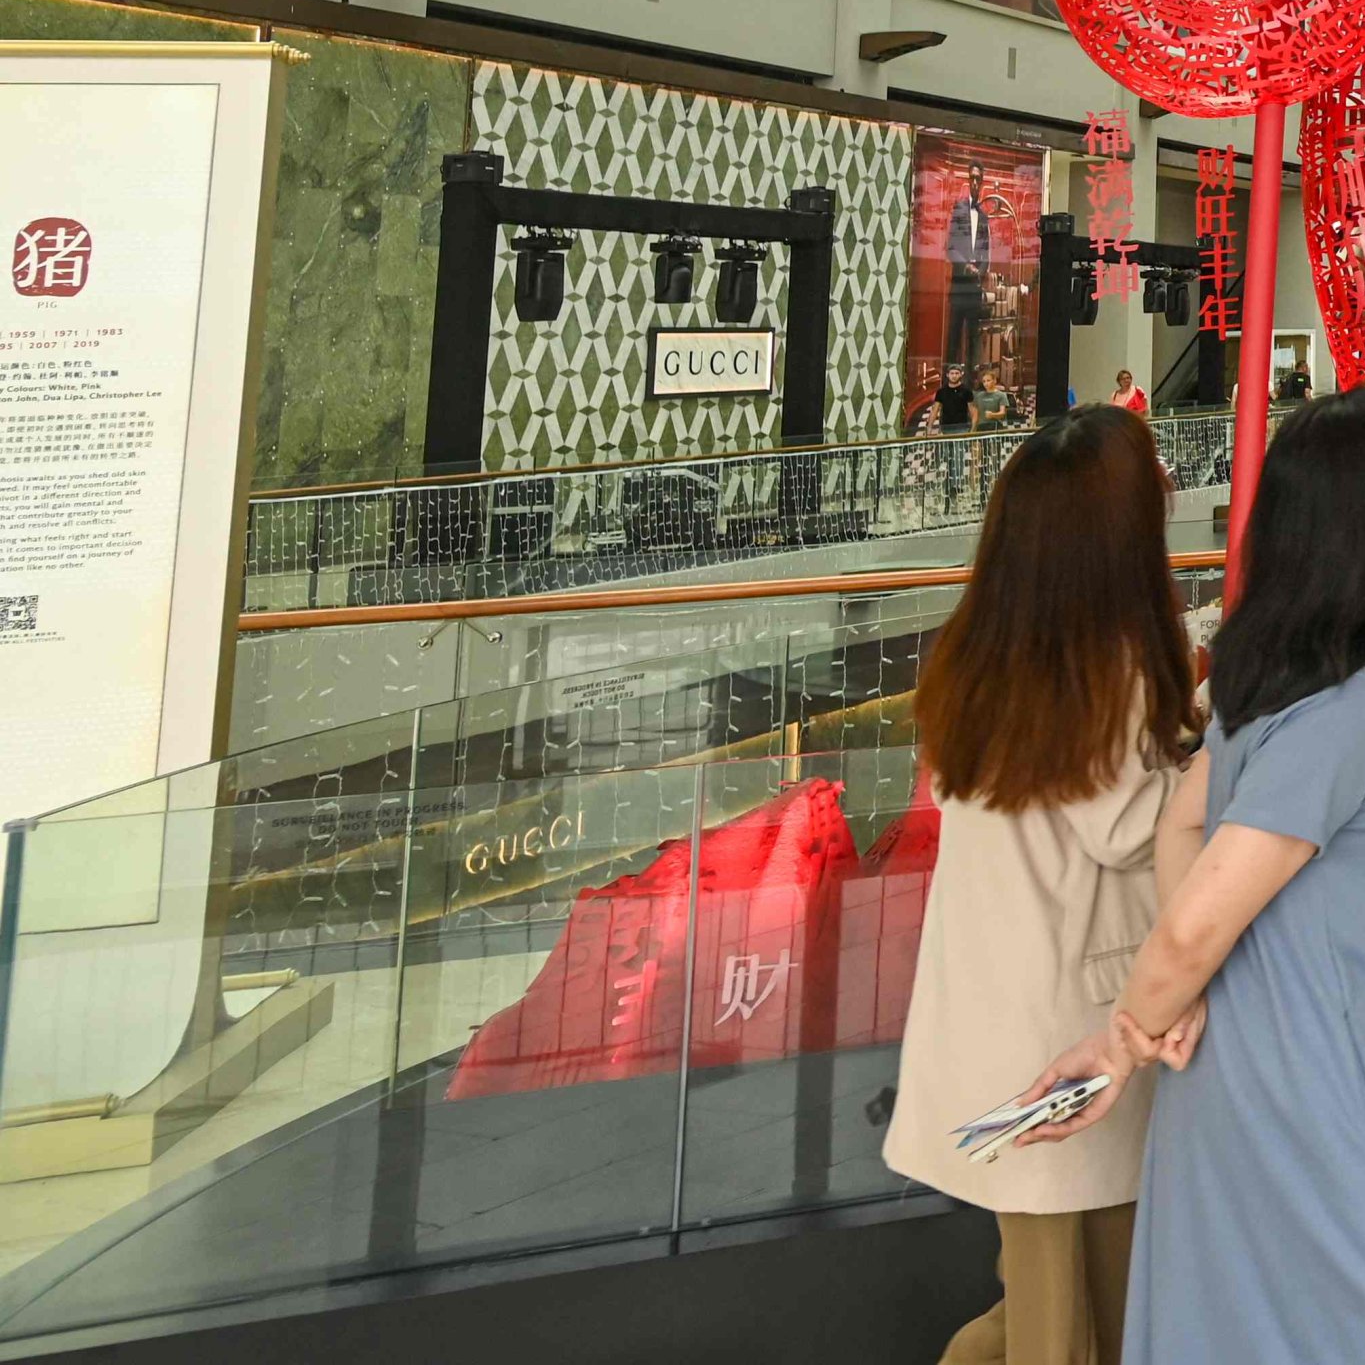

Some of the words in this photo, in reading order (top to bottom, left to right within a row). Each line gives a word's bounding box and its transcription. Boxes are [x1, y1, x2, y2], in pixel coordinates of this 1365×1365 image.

[1082, 108, 1139, 303] 福满乾坤
[1195, 145, 1241, 341] 财旺丰年
[13, 227, 90, 287] 猪
[664, 350, 758, 376] GUCCI
[33, 484, 50, 492] may
[73, 480, 138, 489] uncomfortable
[41, 492, 78, 500] different
[52, 502, 70, 510] gain
[68, 510, 98, 518] greatly
[68, 533, 90, 541] right
[59, 543, 102, 552] important
[28, 553, 63, 563] yourself
[88, 551, 121, 559] journey
[465, 811, 586, 874] GUCCI
[714, 949, 799, 1028] 财
